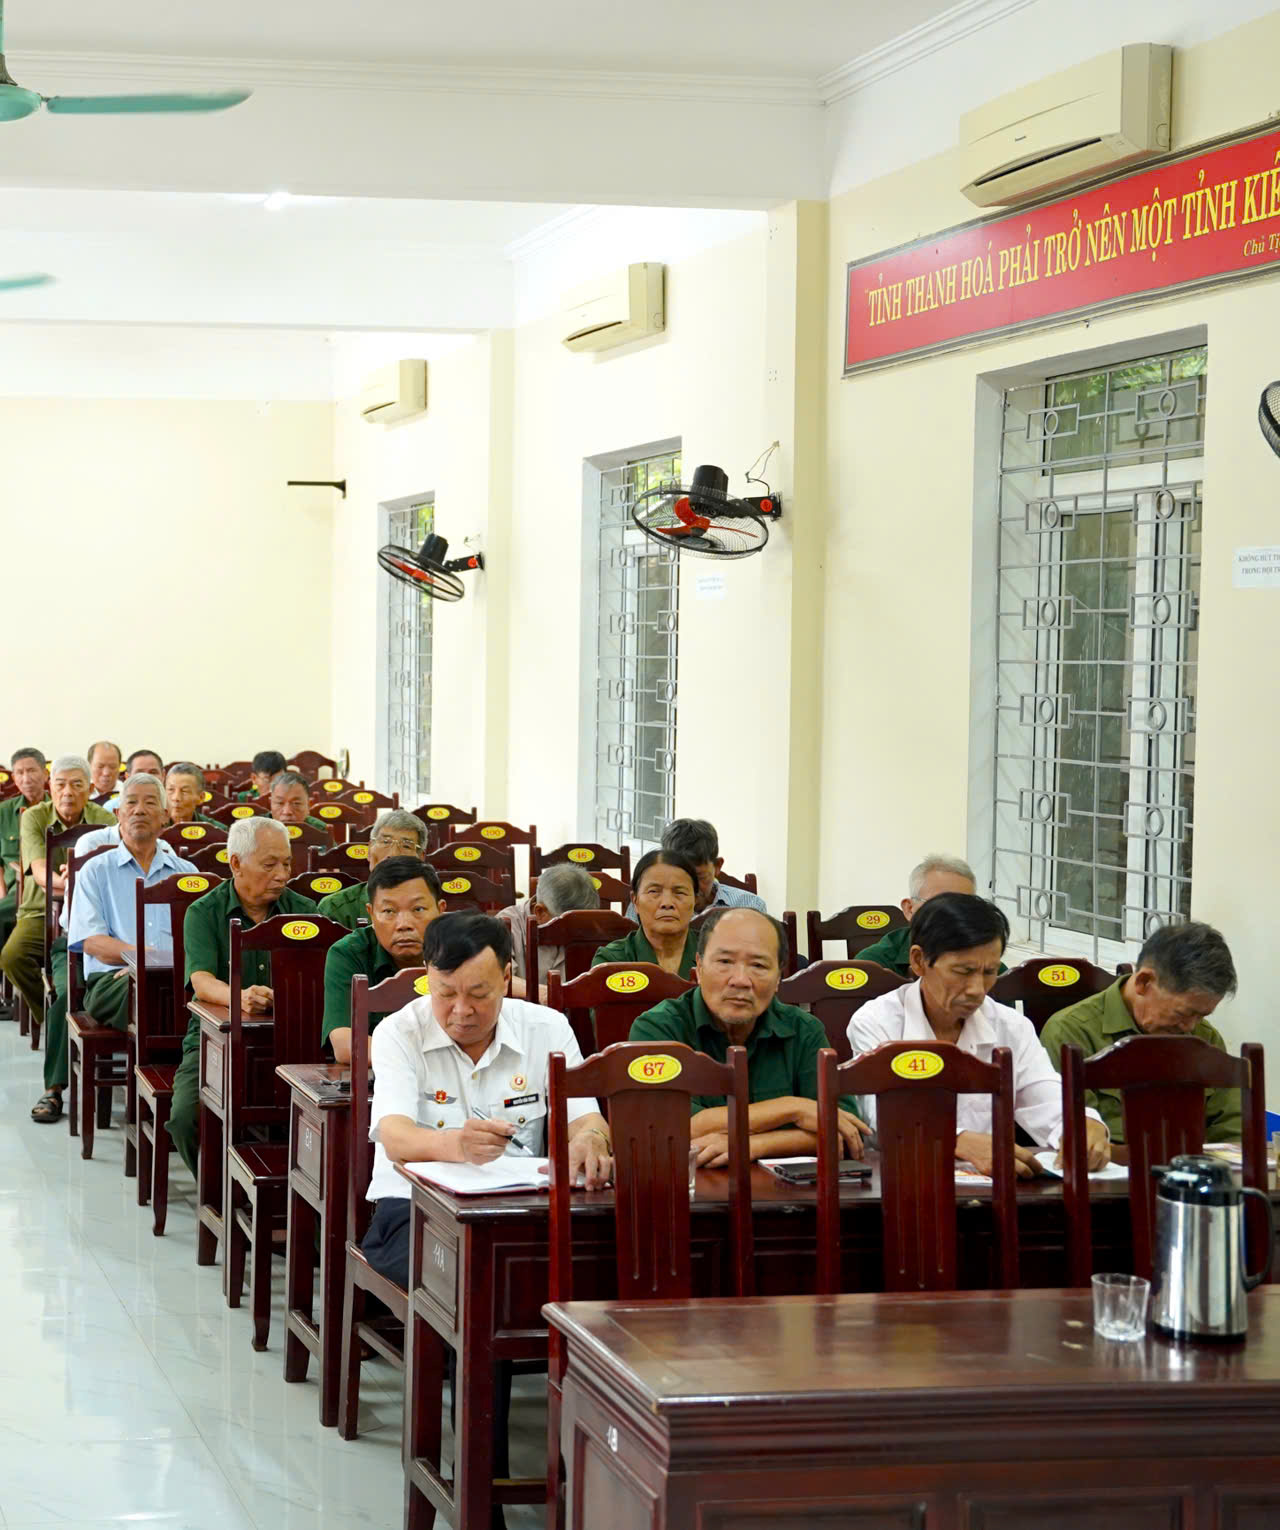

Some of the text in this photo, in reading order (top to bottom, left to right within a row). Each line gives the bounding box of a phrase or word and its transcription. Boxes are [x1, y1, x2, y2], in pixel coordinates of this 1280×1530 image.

[905, 263, 958, 317] THANH
[959, 240, 995, 301] HOÁ
[997, 223, 1041, 291] PHẢI
[1043, 208, 1083, 278] TRỞ
[1084, 202, 1128, 267] NÊN
[1129, 186, 1178, 263] MỘT
[1180, 168, 1239, 241] TỈNH
[185, 879, 201, 889] 98
[319, 880, 333, 890] 57
[448, 880, 463, 890] 36
[866, 914, 881, 925] 29
[292, 925, 309, 936] 67
[619, 975, 636, 988] 18
[839, 973, 855, 985] 19
[1051, 970, 1067, 982] 51
[643, 1061, 666, 1077] 67
[907, 1058, 927, 1072] 41
